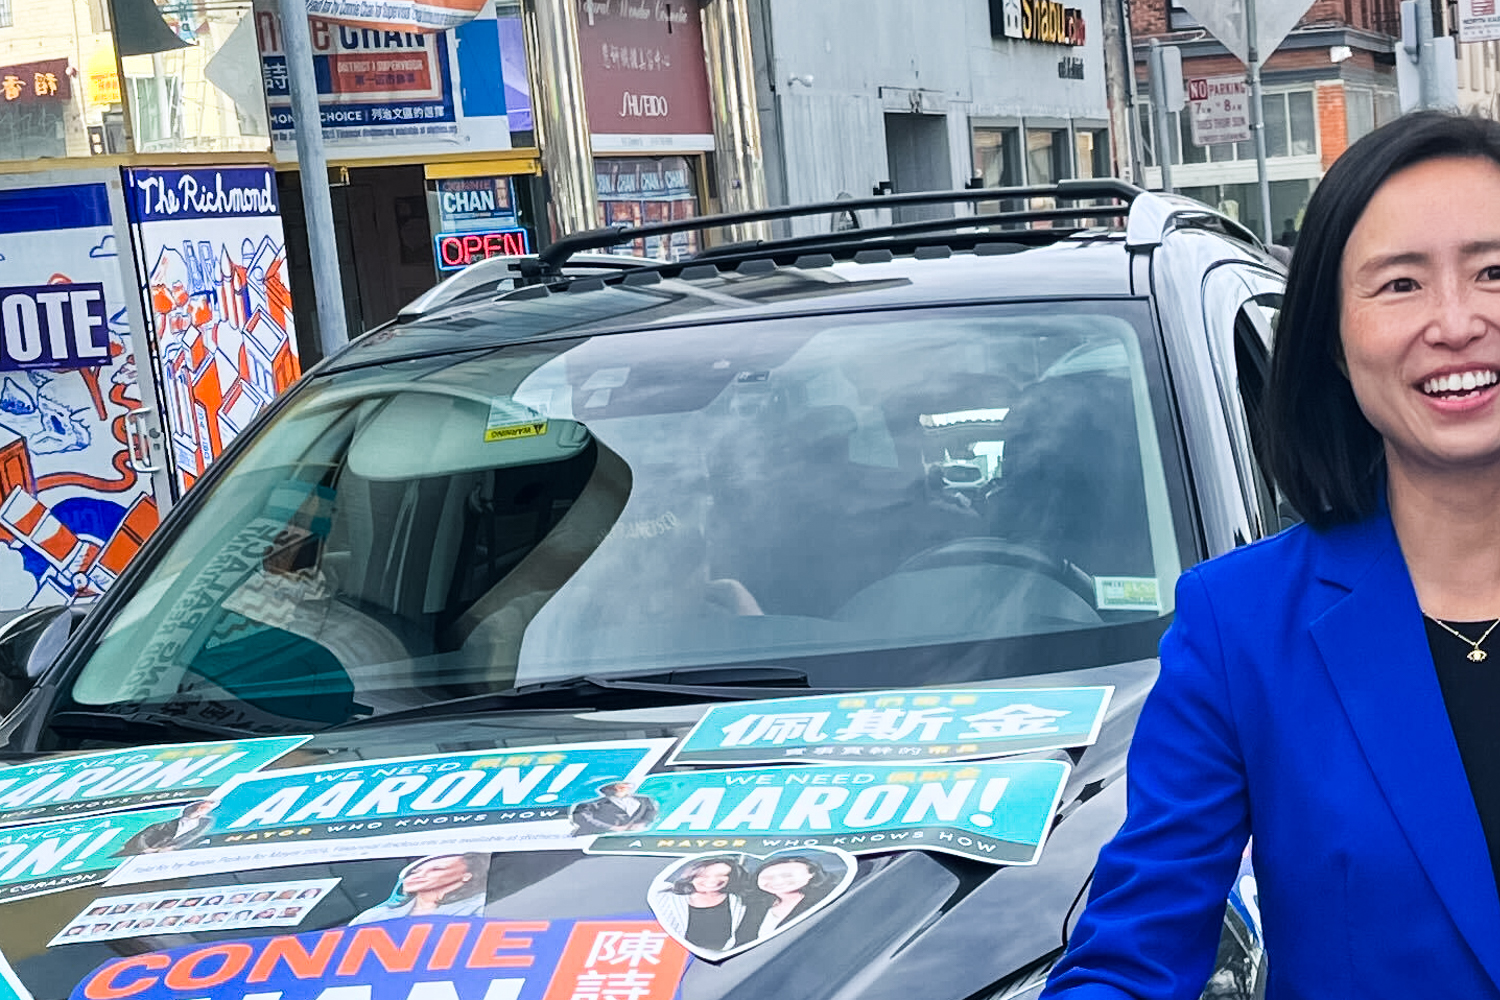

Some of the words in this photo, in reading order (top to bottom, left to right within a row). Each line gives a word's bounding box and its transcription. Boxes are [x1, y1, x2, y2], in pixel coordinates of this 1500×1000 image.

[1190, 80, 1208, 100] NO
[1208, 82, 1246, 96] PARKING
[618, 91, 668, 117] SHISEIDO
[138, 174, 182, 215] The
[178, 171, 277, 214] Richmond
[443, 190, 496, 214] CHAN
[441, 232, 525, 265] OPEN
[2, 289, 108, 363] OTE
[720, 703, 1072, 748] 佩斯金
[314, 769, 361, 785] WE
[369, 761, 463, 778] NEED
[725, 773, 779, 786] WE
[785, 772, 876, 786] NEED
[55, 797, 132, 812] KNOWS
[227, 763, 589, 829] AARON!
[662, 777, 1012, 831] AARON!
[327, 821, 383, 835] WHO
[395, 813, 489, 829] KNOWS
[500, 809, 560, 821] HOW
[628, 839, 643, 848] A
[762, 837, 818, 848] WHO
[832, 830, 925, 846] KNOWS
[937, 830, 998, 853] HOW
[84, 921, 549, 1000] CONNIE
